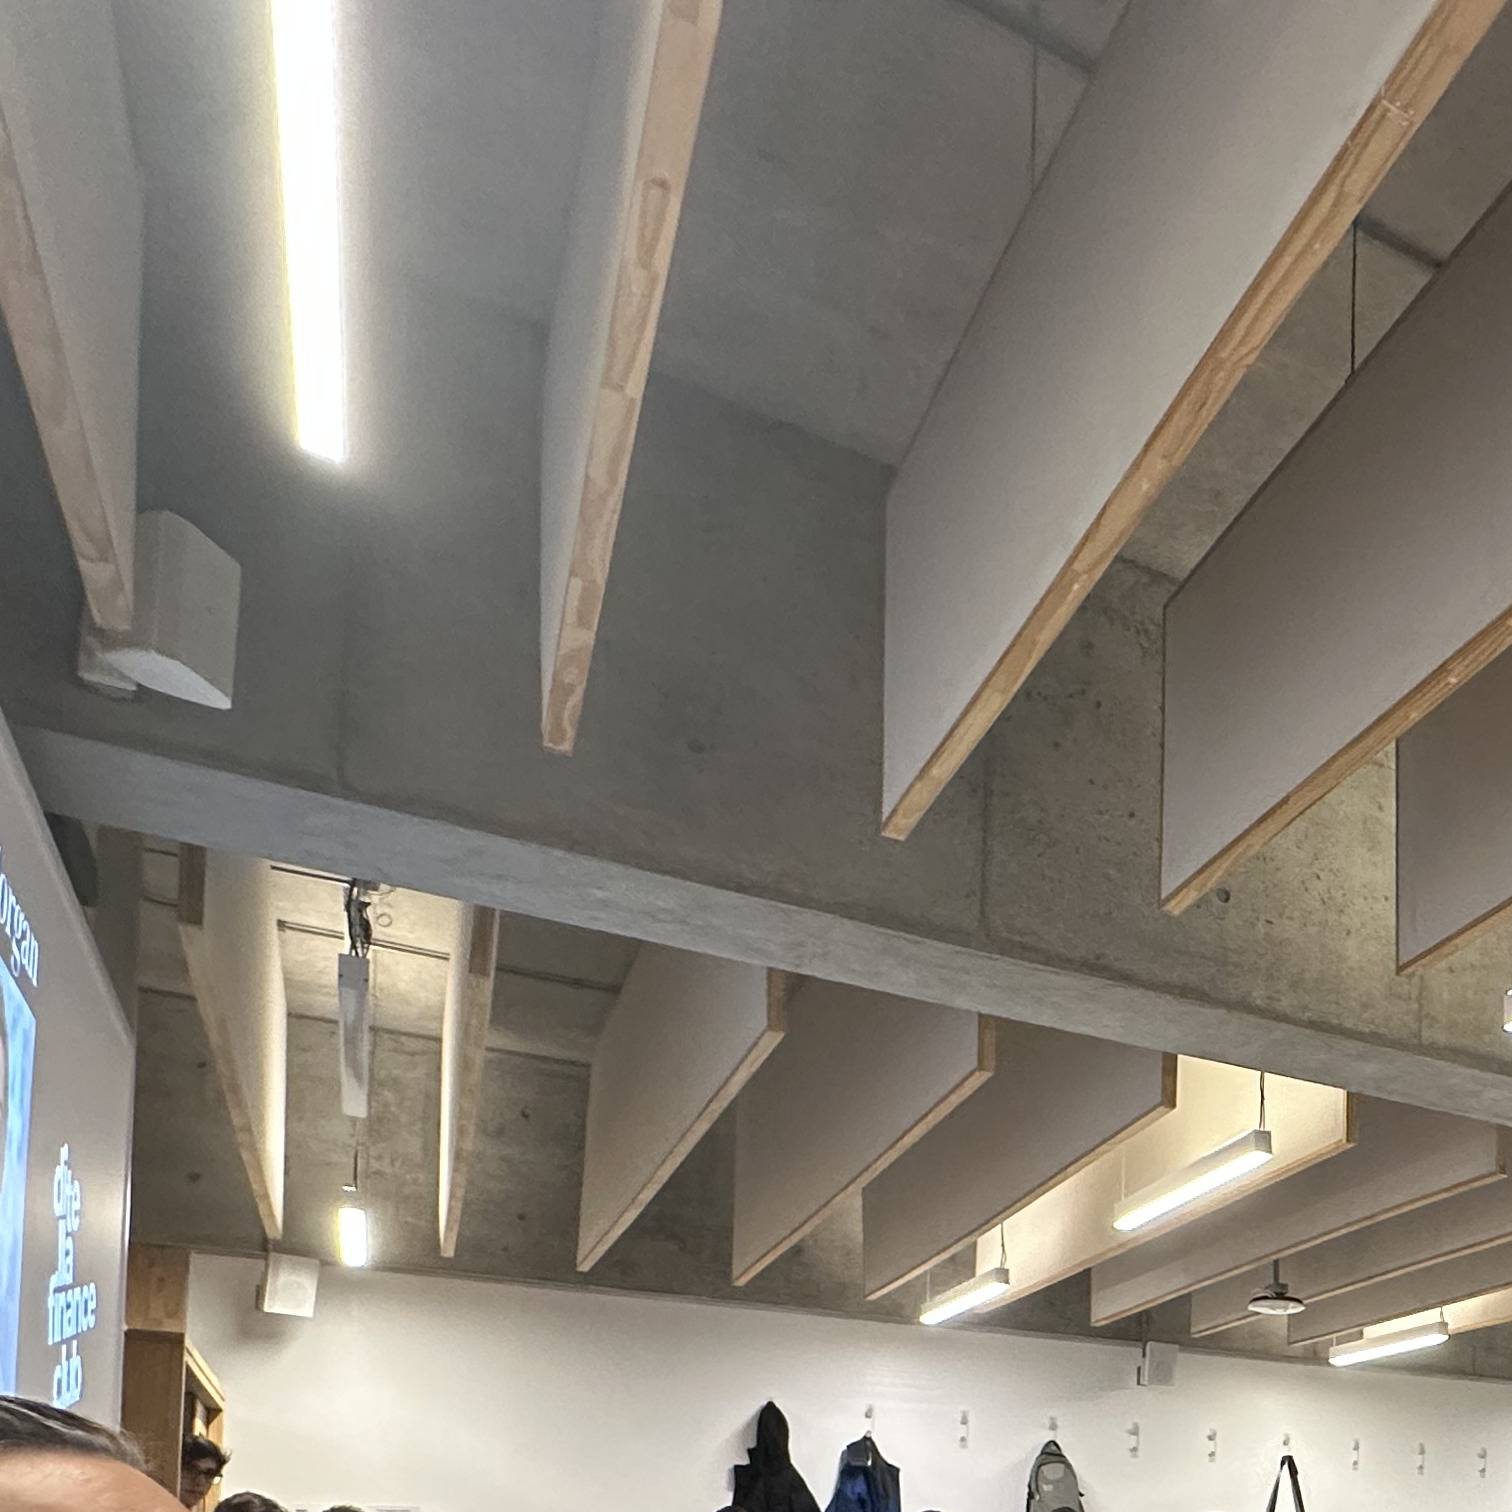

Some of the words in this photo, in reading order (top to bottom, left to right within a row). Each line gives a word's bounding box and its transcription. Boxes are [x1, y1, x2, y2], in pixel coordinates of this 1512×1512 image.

[0, 873, 39, 988] organ
[48, 1270, 97, 1346] finance
[53, 1339, 82, 1410] club
